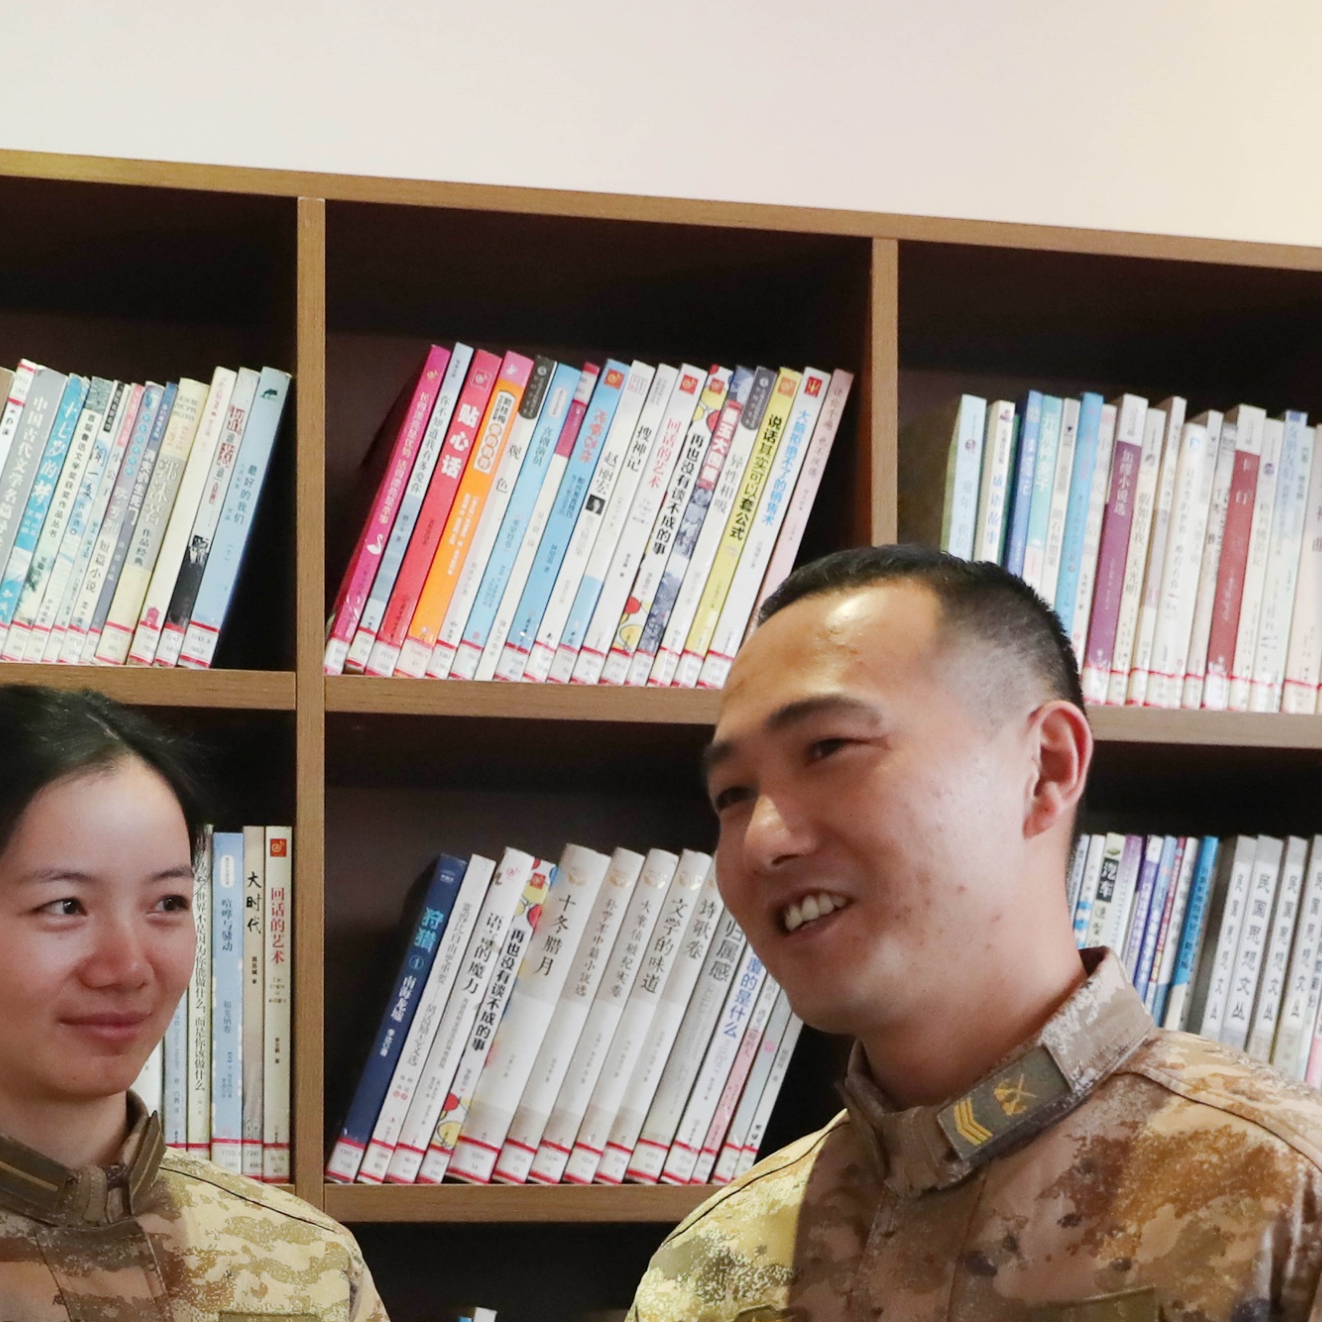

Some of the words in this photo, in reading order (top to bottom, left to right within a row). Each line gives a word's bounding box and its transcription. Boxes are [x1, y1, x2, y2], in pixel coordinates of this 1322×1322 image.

[32, 400, 78, 505] 十七岁的梦
[411, 395, 450, 495] 你不知道我有多爱你
[440, 402, 480, 479] 贴心话
[495, 443, 523, 494] 观色
[595, 451, 619, 496] 赵丽宏
[627, 425, 653, 472] 搜神记
[648, 418, 682, 489] 回话的艺术
[728, 413, 784, 541] 说话其实可以套公式
[761, 410, 810, 527] 大脑拒绝不了的销售术
[233, 464, 258, 525] 最好的我们
[652, 433, 706, 556] 再也没有谈不成的事
[714, 454, 744, 514] 异性相吸
[246, 870, 263, 935] 大时代
[270, 887, 286, 965] 回话的艺术
[413, 906, 445, 953] 狩猎
[534, 894, 577, 978] 十冬腊月
[685, 899, 718, 961] 诗歌卷
[640, 898, 686, 994] 文学的味道
[710, 917, 744, 983] 归属感
[1231, 872, 1272, 1021] 民国思想文丛
[471, 928, 526, 1052] 再也没有谈不成的事
